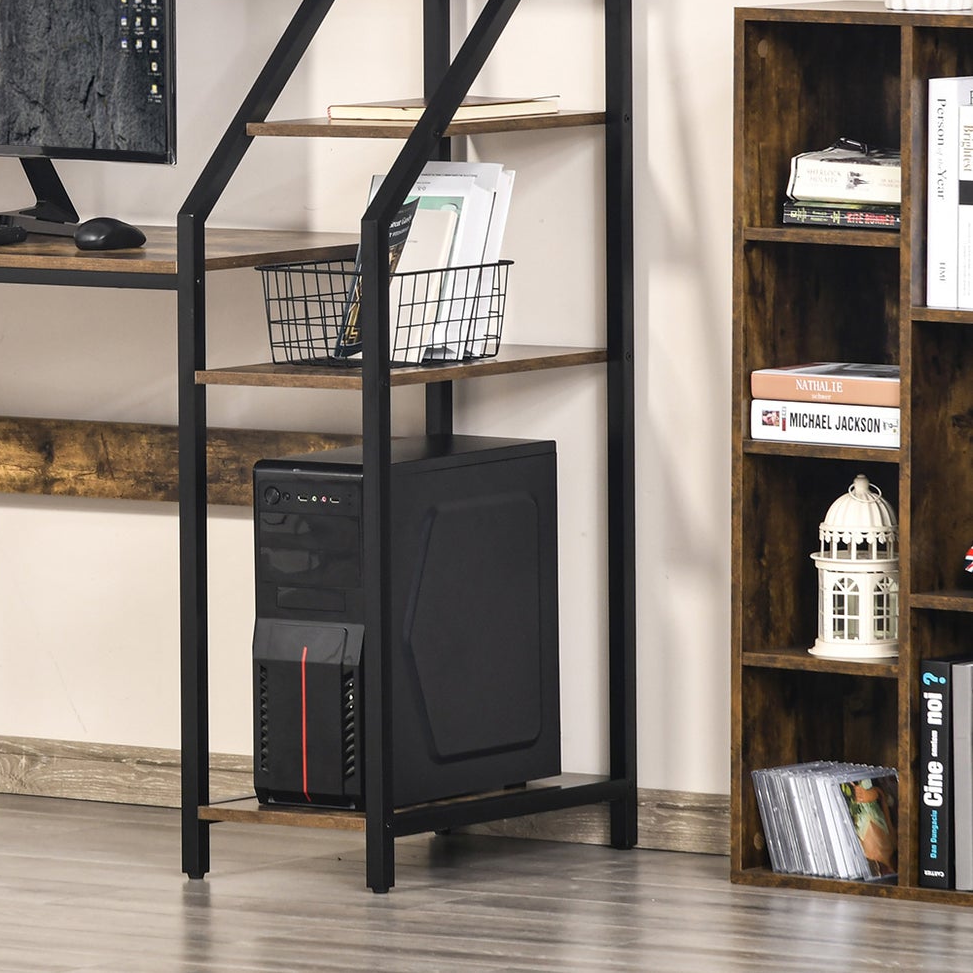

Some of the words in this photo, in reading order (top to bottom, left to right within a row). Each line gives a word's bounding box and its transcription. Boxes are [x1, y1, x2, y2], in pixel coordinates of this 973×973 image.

[936, 98, 947, 146] Person
[961, 125, 973, 171] Brightest
[936, 169, 947, 200] Year
[795, 378, 843, 393] NATHALIE
[789, 412, 832, 430] MICHAEL
[835, 415, 881, 433] JACKSON
[923, 692, 943, 725] noi
[923, 760, 944, 807] Cine
